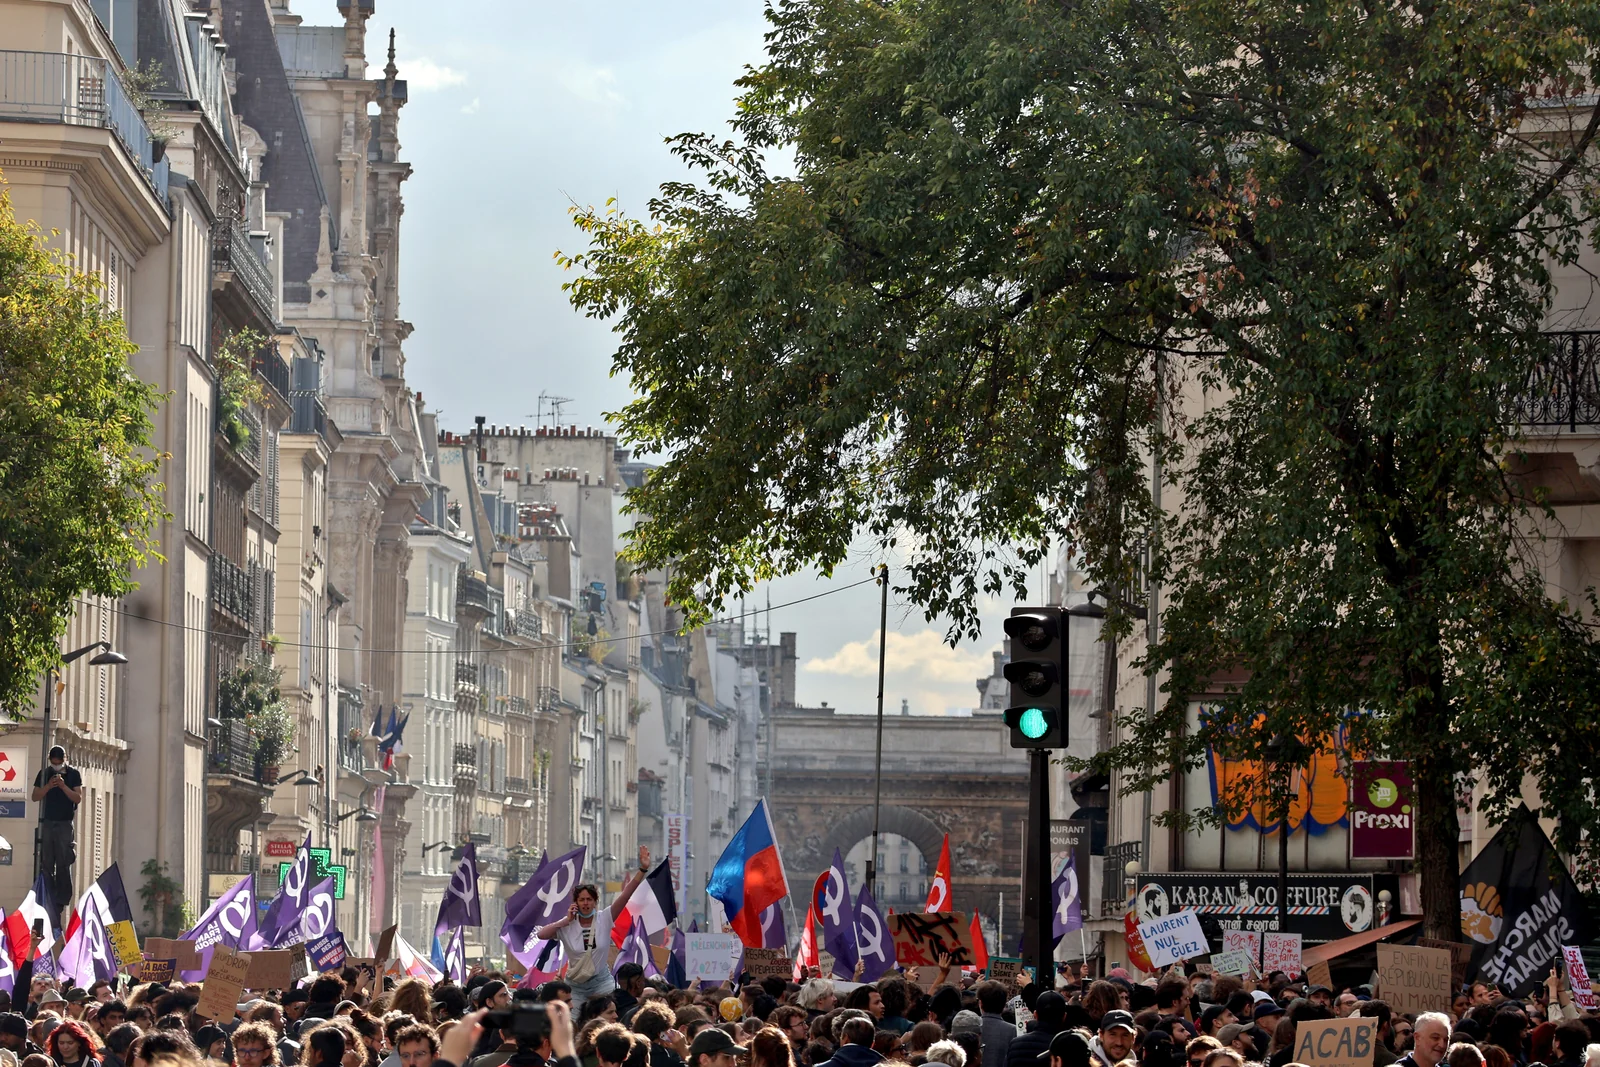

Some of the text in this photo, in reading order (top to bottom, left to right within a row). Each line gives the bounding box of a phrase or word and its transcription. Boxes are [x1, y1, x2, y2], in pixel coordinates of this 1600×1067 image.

[1354, 804, 1411, 830] Proxi
[1050, 825, 1085, 834] AURANT
[668, 828, 681, 912] SPLEND
[1172, 885, 1341, 907] KARAN COFFURE
[1141, 915, 1190, 940] LAURENT
[310, 936, 330, 954] BAISSE
[1154, 935, 1181, 951] NUL
[1170, 940, 1200, 958] GUEZ
[744, 947, 777, 960] REGARDE
[690, 957, 717, 975] 2027
[993, 959, 1016, 971] ÊTRE
[1436, 956, 1449, 971] LA
[1382, 991, 1452, 1013] EN MARCHE
